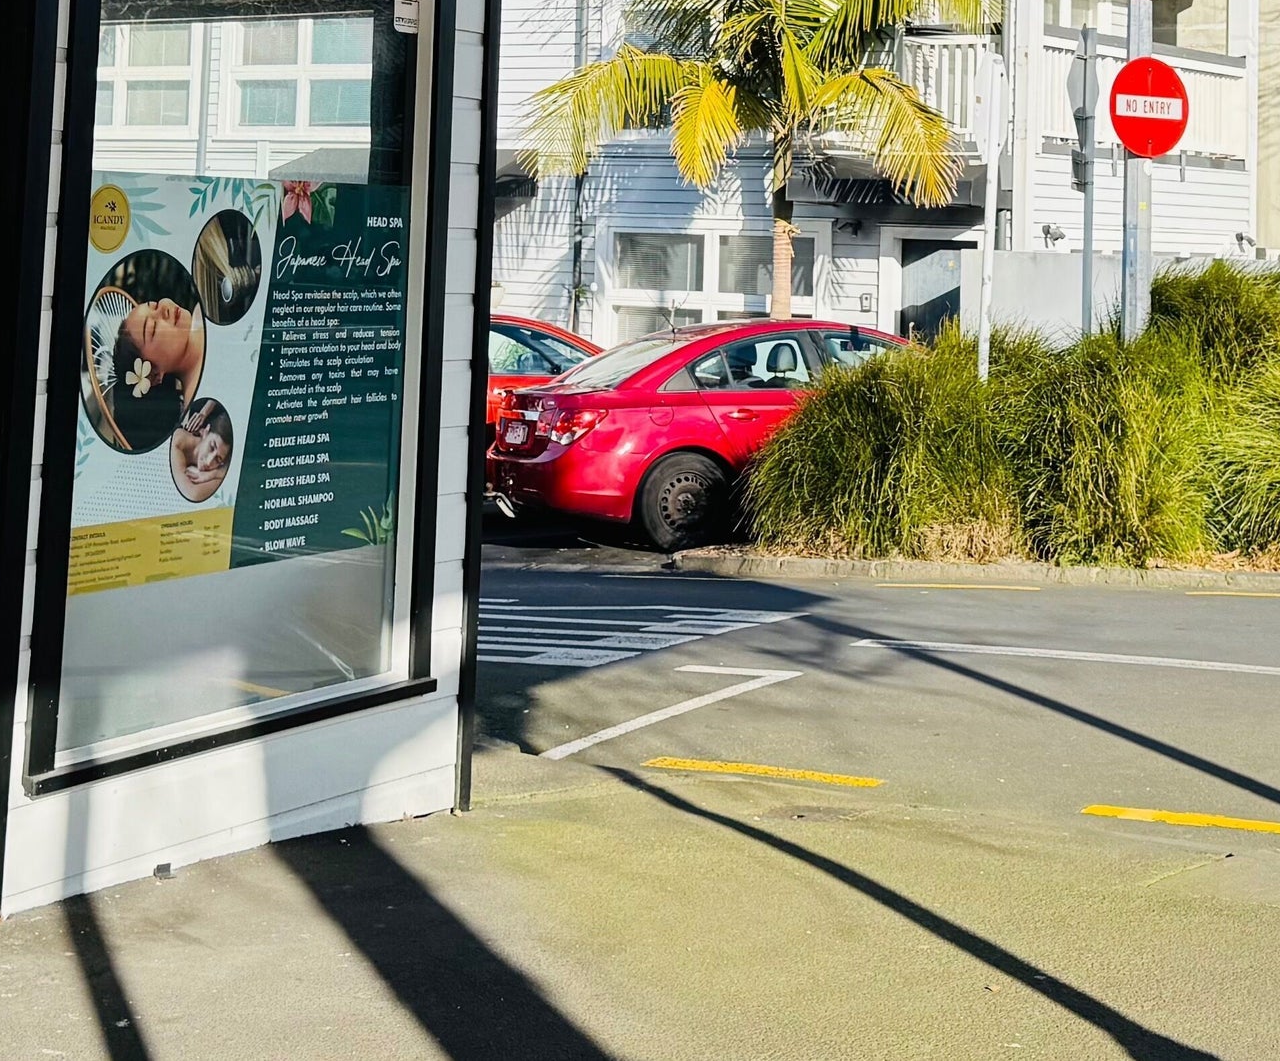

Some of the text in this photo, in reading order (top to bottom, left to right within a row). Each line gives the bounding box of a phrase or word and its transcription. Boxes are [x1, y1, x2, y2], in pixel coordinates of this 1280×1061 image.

[1126, 99, 1171, 114] NO ENTRY
[94, 215, 124, 225] ICANDY
[367, 217, 403, 228] HEAD SPA
[277, 236, 401, 279] Japanese Head Spa
[273, 290, 290, 300] Head
[292, 290, 302, 301] Spa
[304, 290, 331, 300] revitalize
[332, 290, 341, 298] the
[361, 289, 377, 298] which
[272, 303, 295, 315] neglect
[296, 304, 302, 312] in
[314, 302, 336, 314] regular
[337, 302, 348, 312] hair
[350, 304, 362, 312] care
[386, 302, 402, 311] Some
[272, 317, 296, 328] benefits
[297, 317, 304, 326] of
[310, 316, 326, 326] head
[282, 328, 400, 340] Relieves stress and reduces tension
[281, 340, 401, 355] Improves circulation to your head and body
[280, 354, 374, 368] Stimulates the scalp circulation
[280, 372, 306, 382] Removes
[312, 373, 323, 382] any
[351, 368, 362, 377] that
[367, 369, 380, 378] may
[385, 366, 398, 375] have
[268, 382, 341, 397] accumulated in the scalp
[276, 392, 397, 410] Activates the dormant hair follicles to
[265, 410, 328, 426] promote new growth
[269, 433, 330, 448] DELUXE HEAD SPA
[267, 453, 330, 468] CLASSIC HEAD SPA
[265, 473, 330, 489] EXPRESS HEAD SPA
[264, 492, 334, 510] NORMAL SHAMPOO
[264, 514, 319, 530] BODY MASSAGE
[265, 536, 306, 552] BLOW WAVE
